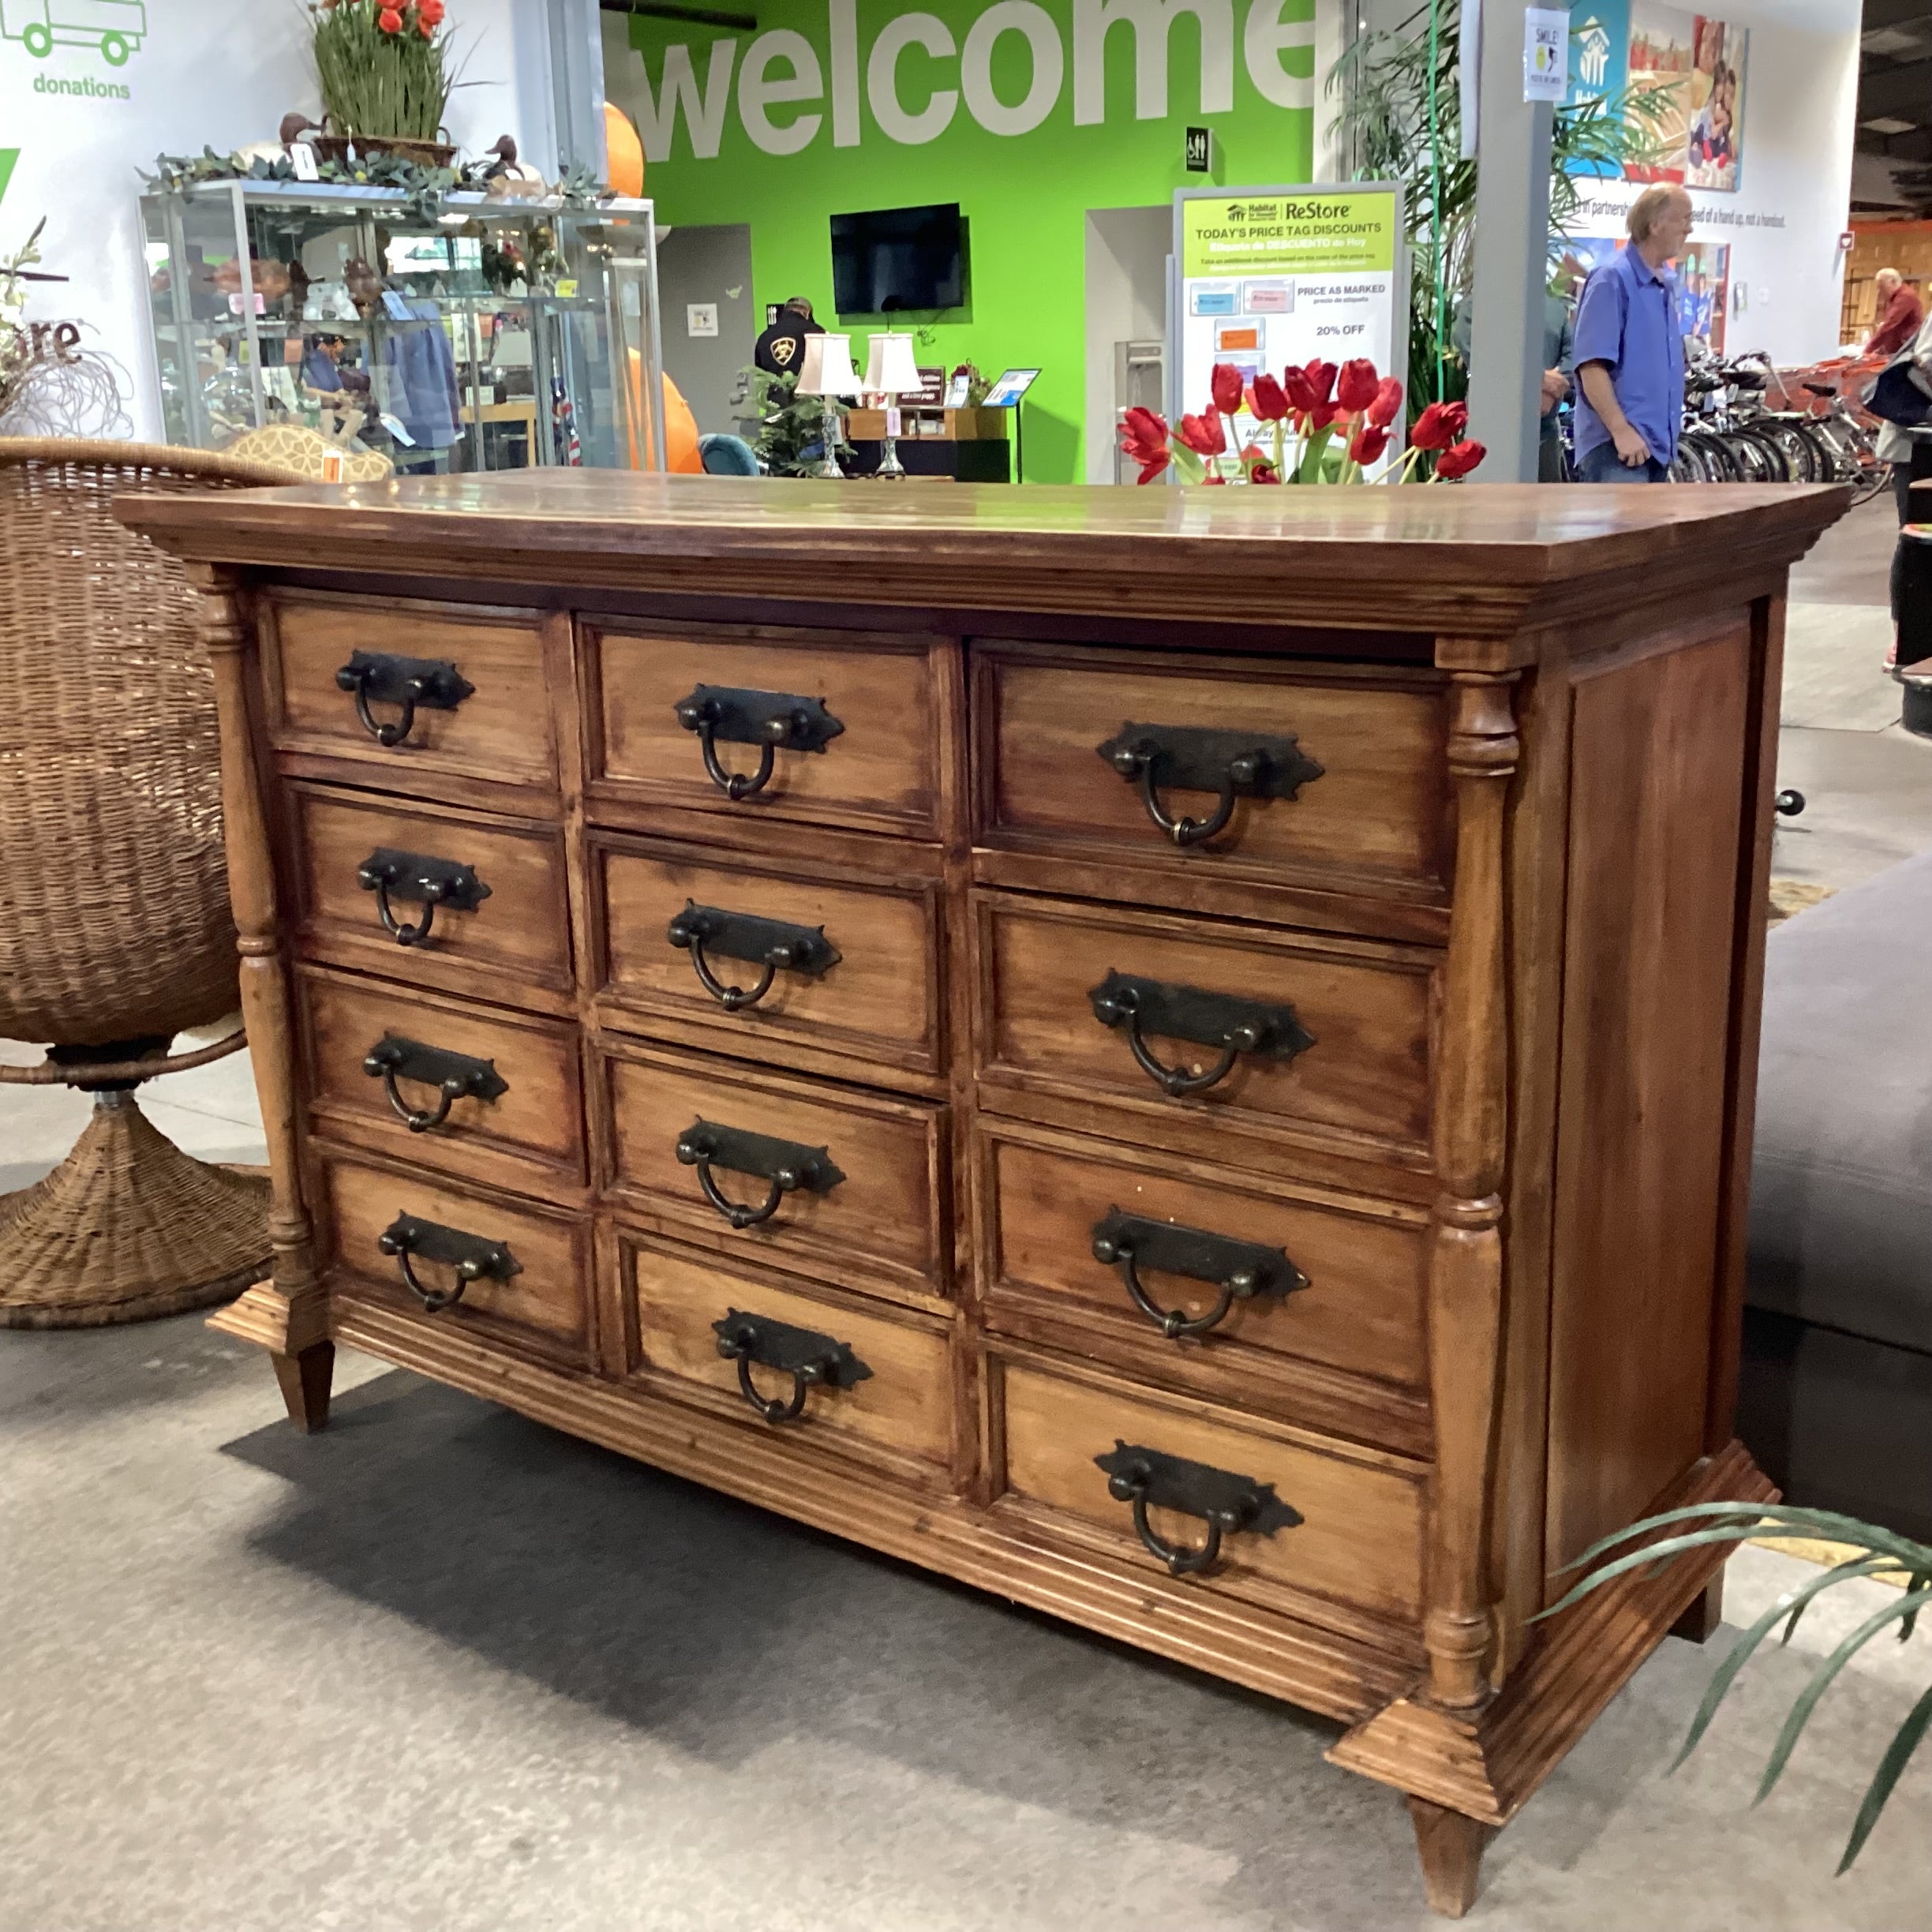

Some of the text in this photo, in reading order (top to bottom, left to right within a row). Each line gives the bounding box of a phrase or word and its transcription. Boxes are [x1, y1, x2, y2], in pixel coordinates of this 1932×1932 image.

[33, 73, 131, 100] donations
[632, 0, 1314, 163] welcome
[1286, 201, 1350, 220] ReStore
[1592, 200, 1630, 218] partnersh
[1690, 207, 1705, 223] eed
[1196, 223, 1382, 240] TODAY'S PRICE TAG DISCOUNTS
[1266, 238, 1331, 250] DESCUENTO
[1346, 238, 1367, 248] Hoy
[1297, 284, 1386, 296] PRICE AS MARKED
[1316, 324, 1365, 335] 20% OFF
